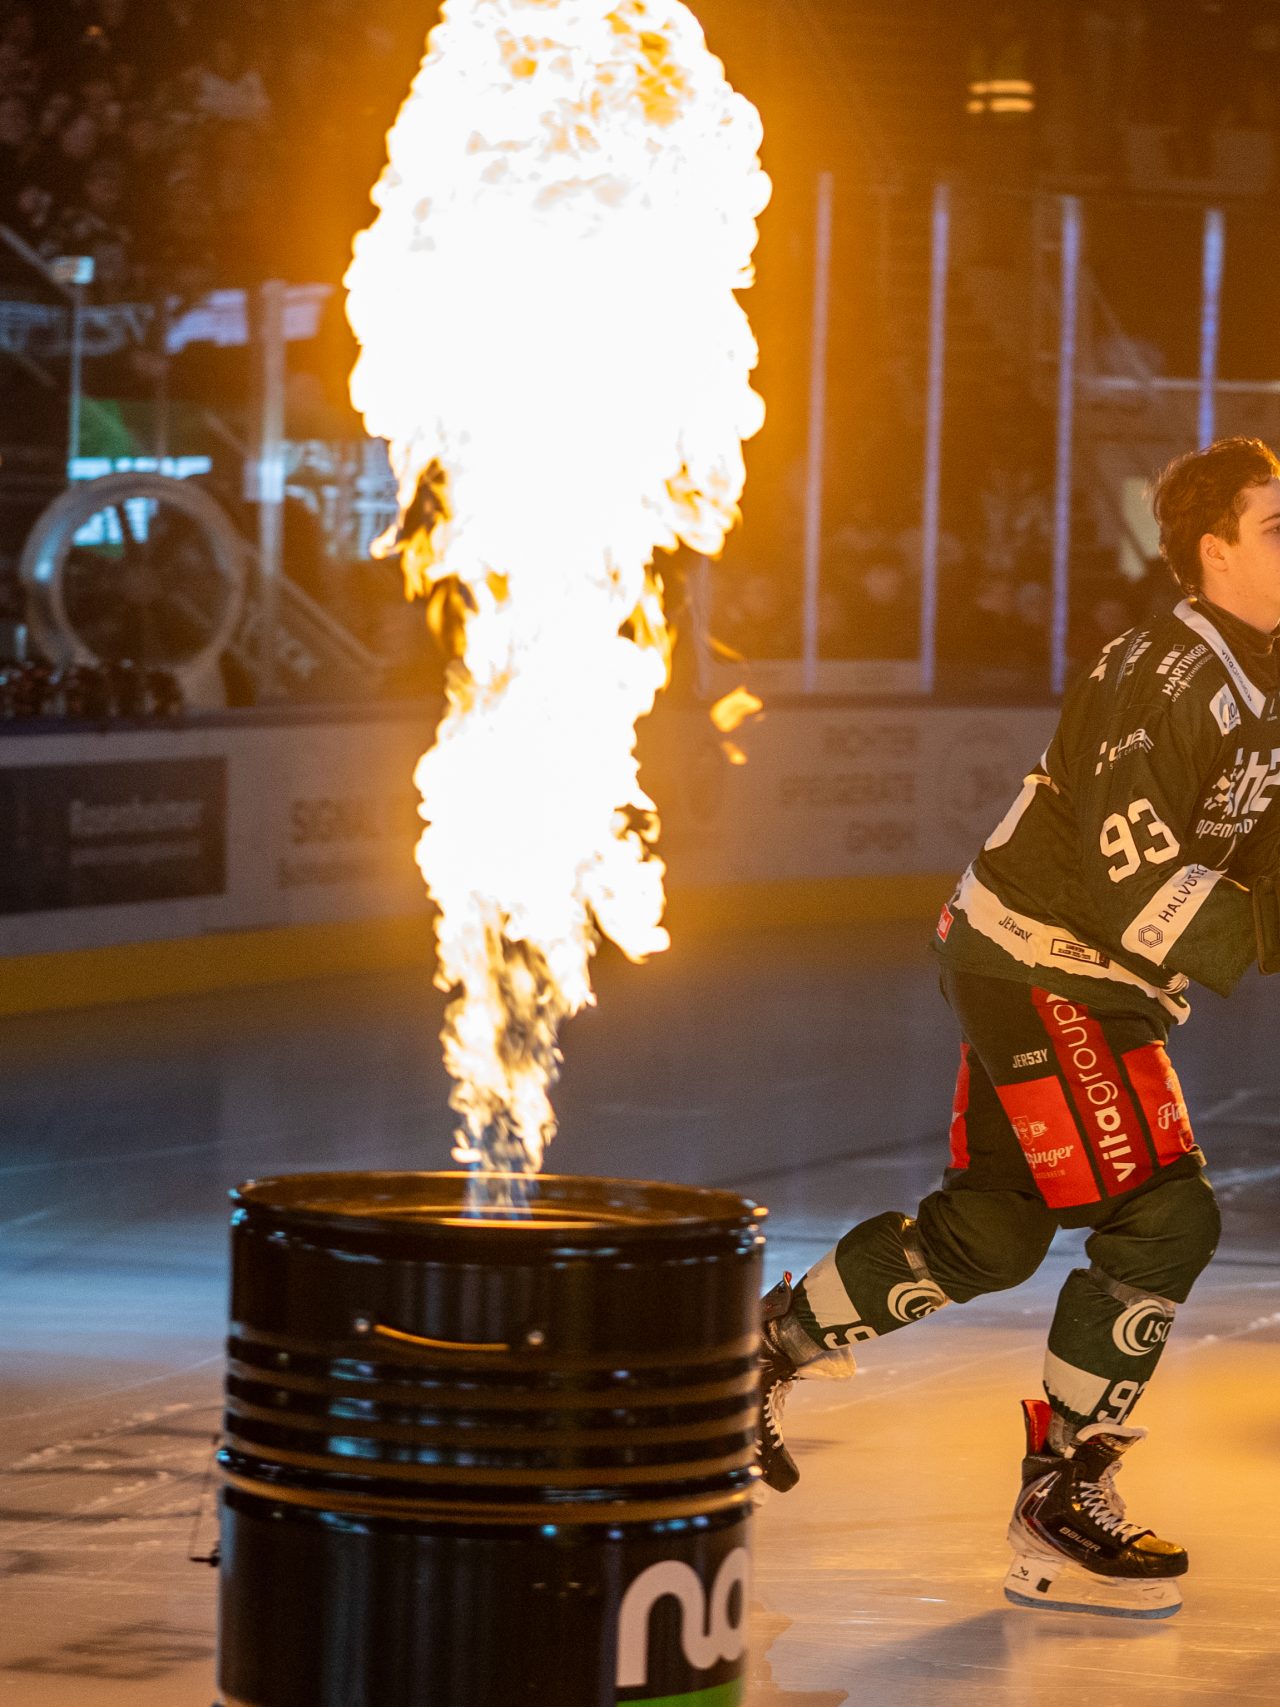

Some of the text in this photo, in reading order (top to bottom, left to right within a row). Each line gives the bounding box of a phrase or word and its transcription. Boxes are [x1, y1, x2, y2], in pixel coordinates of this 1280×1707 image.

[1161, 643, 1208, 697] HARTINGER
[1100, 798, 1180, 883] 93
[1012, 1048, 1048, 1069] JER53Y
[1053, 1004, 1137, 1183] vitagroup
[1059, 1526, 1102, 1553] BAUER
